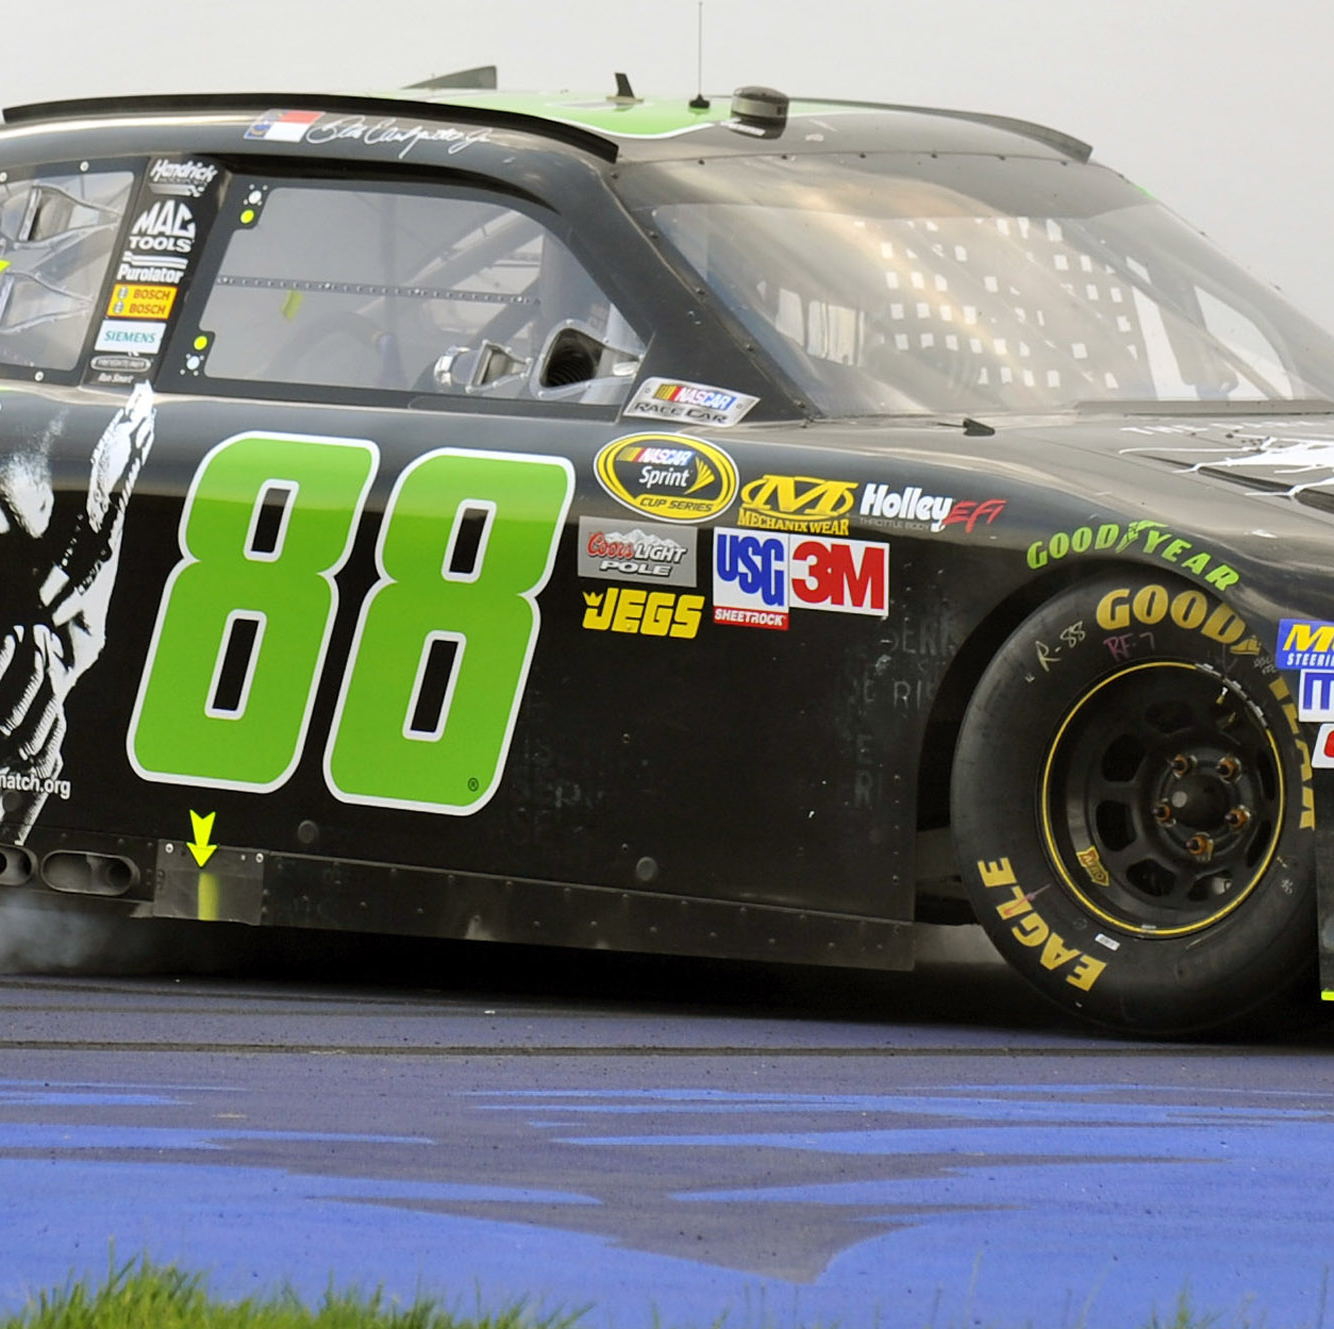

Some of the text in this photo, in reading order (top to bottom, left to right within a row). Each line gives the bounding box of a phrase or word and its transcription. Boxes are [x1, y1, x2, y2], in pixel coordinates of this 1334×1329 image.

[150, 159, 218, 183] Hendrick
[131, 200, 196, 239] MAC
[129, 236, 192, 252] TOOLS
[116, 263, 184, 284] Purolator
[133, 288, 171, 301] BOSCH
[129, 303, 166, 315] BOSCH
[104, 330, 156, 343] SIEMENS
[674, 387, 731, 411] NASCAR
[686, 407, 729, 423] CAR
[638, 447, 693, 466] NASCAR
[639, 465, 691, 489] Sprint
[640, 497, 714, 512] CUP SERIES
[860, 483, 953, 533] Holley
[737, 507, 850, 537] MECHANIX WEAR
[587, 532, 688, 564] Coors LIGHT
[599, 560, 672, 578] POLE
[717, 533, 785, 606] USG
[791, 540, 885, 610] 3M
[126, 430, 576, 817] 88
[582, 587, 705, 639] JEGS
[714, 608, 783, 626] SHEETROCK
[977, 857, 1107, 992] EAGLE
